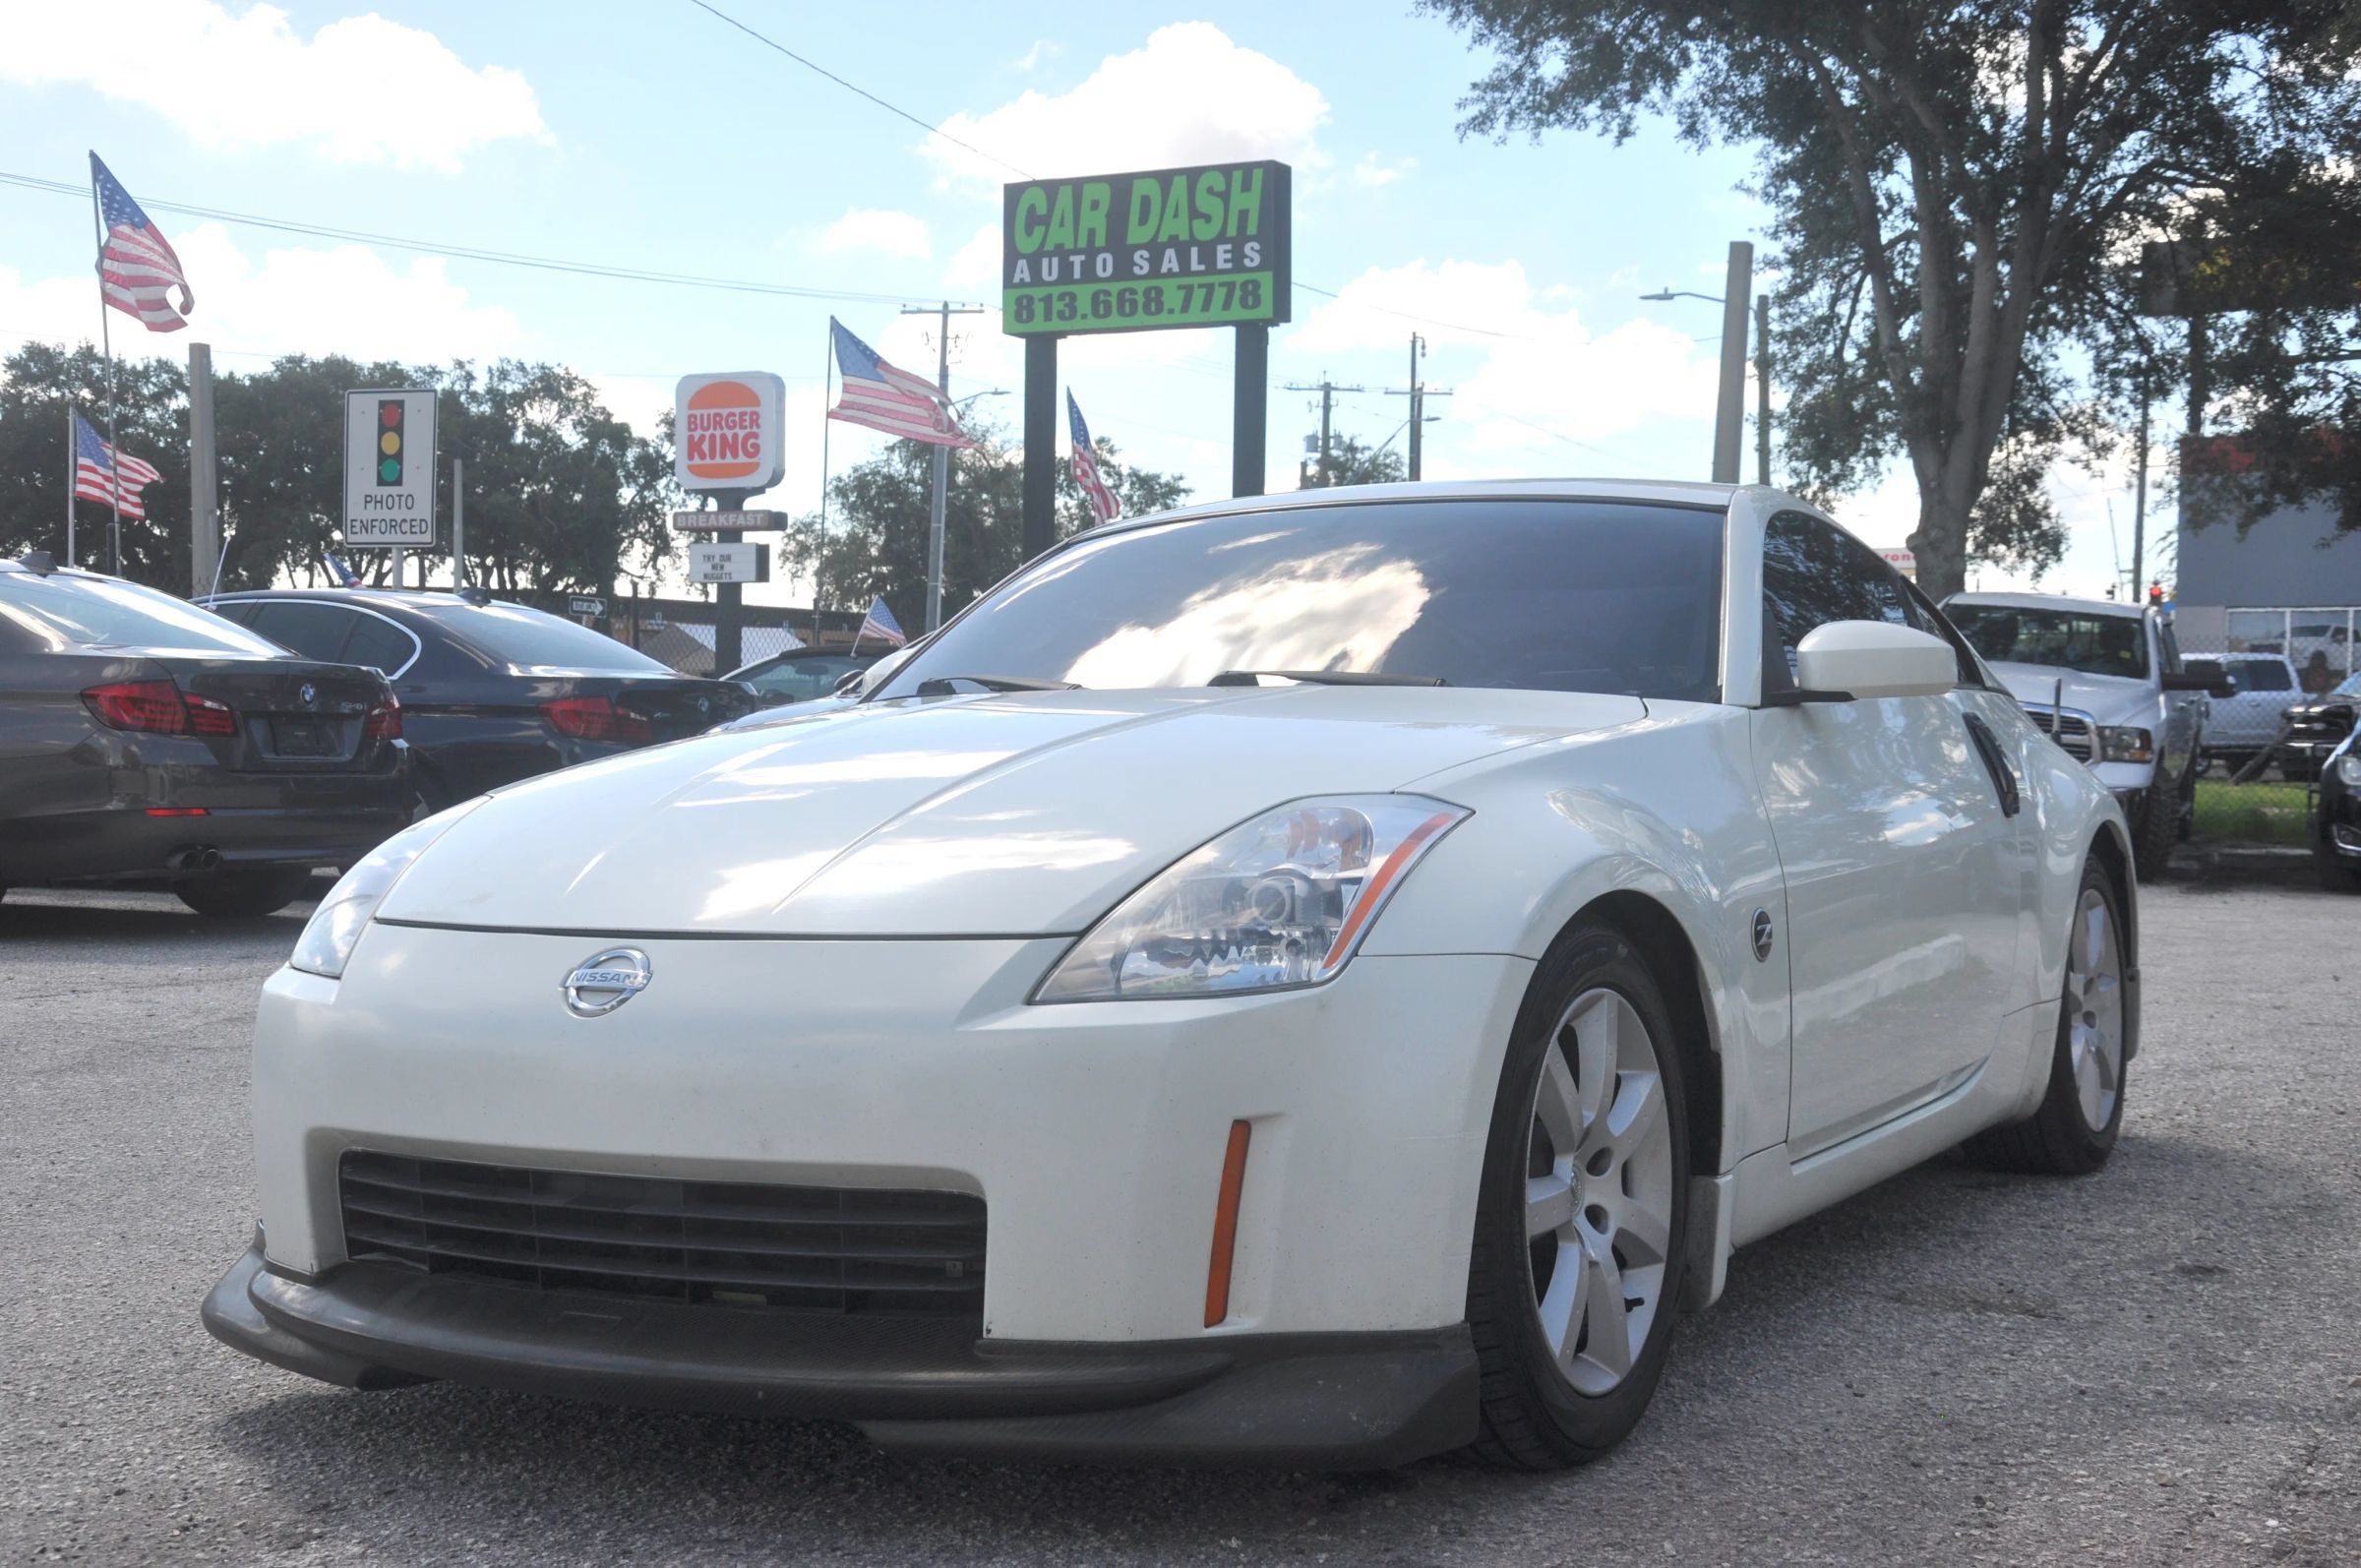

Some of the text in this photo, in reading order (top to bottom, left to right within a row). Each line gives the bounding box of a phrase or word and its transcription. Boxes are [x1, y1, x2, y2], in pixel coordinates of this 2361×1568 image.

[1013, 167, 1263, 254] CAR DASH
[1012, 241, 1261, 283] AUTO SALES
[1013, 279, 1261, 324] 813.668.7778
[687, 410, 761, 432] BURGER
[687, 431, 761, 461] KING
[364, 494, 414, 511] PHOTO
[350, 518, 429, 534] ENFORCED
[677, 513, 764, 527] BREAKFAST
[702, 554, 732, 563] TRY OUR
[572, 972, 636, 984] NISSAN
